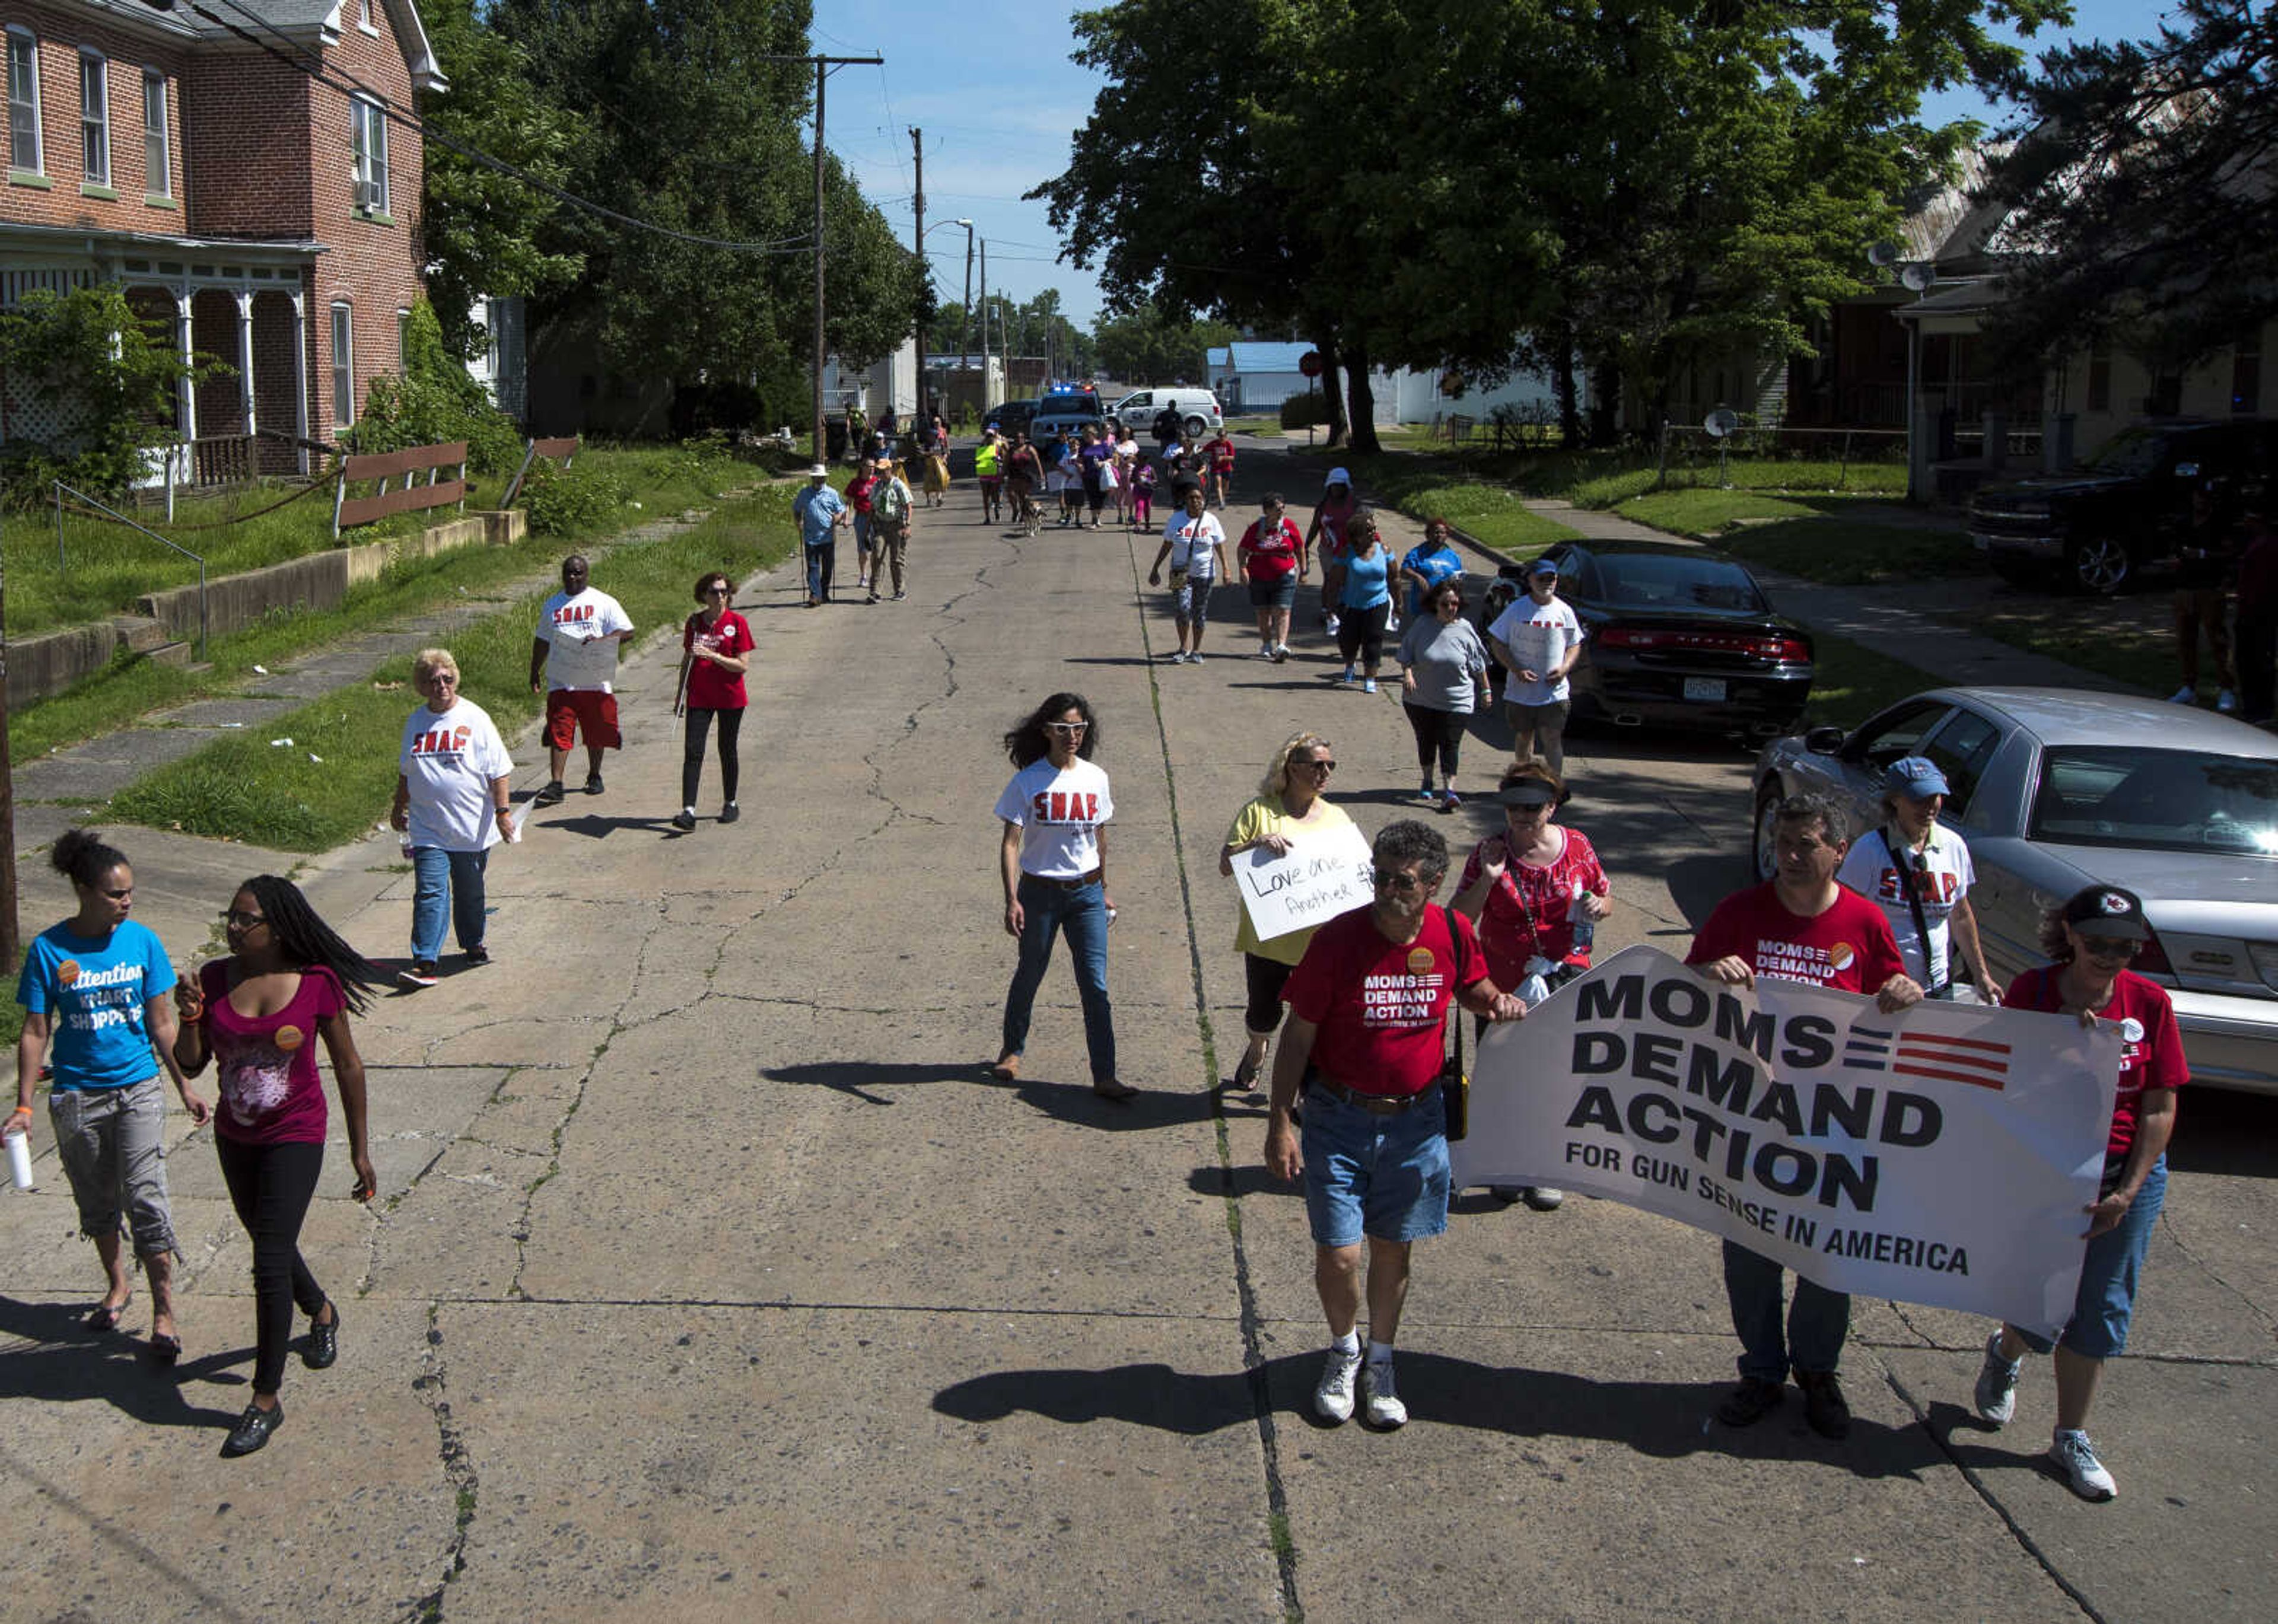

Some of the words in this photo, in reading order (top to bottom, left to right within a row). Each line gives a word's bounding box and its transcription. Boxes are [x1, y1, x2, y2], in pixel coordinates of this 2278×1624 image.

[554, 605, 594, 623] SNAP
[1034, 791, 1098, 821] SNAP
[1247, 867, 1306, 898] Love
[1879, 868, 1957, 903] SAP
[1757, 939, 1815, 960] MOMS
[1755, 954, 1835, 978] DEMAND
[1365, 975, 1417, 989] MOMS
[1365, 989, 1437, 1004] DEMAND
[1364, 1004, 1428, 1019] ACTION
[1576, 975, 1836, 1068] MOMS
[1572, 1031, 1943, 1147] DEMAND
[1565, 1086, 1879, 1212] ACTION
[1566, 1142, 1621, 1172] FOR
[1632, 1155, 1689, 1191] GUN
[1697, 1175, 1778, 1235] SENSE
[1784, 1214, 1816, 1247] IN
[1823, 1228, 1970, 1276] AMERICA
